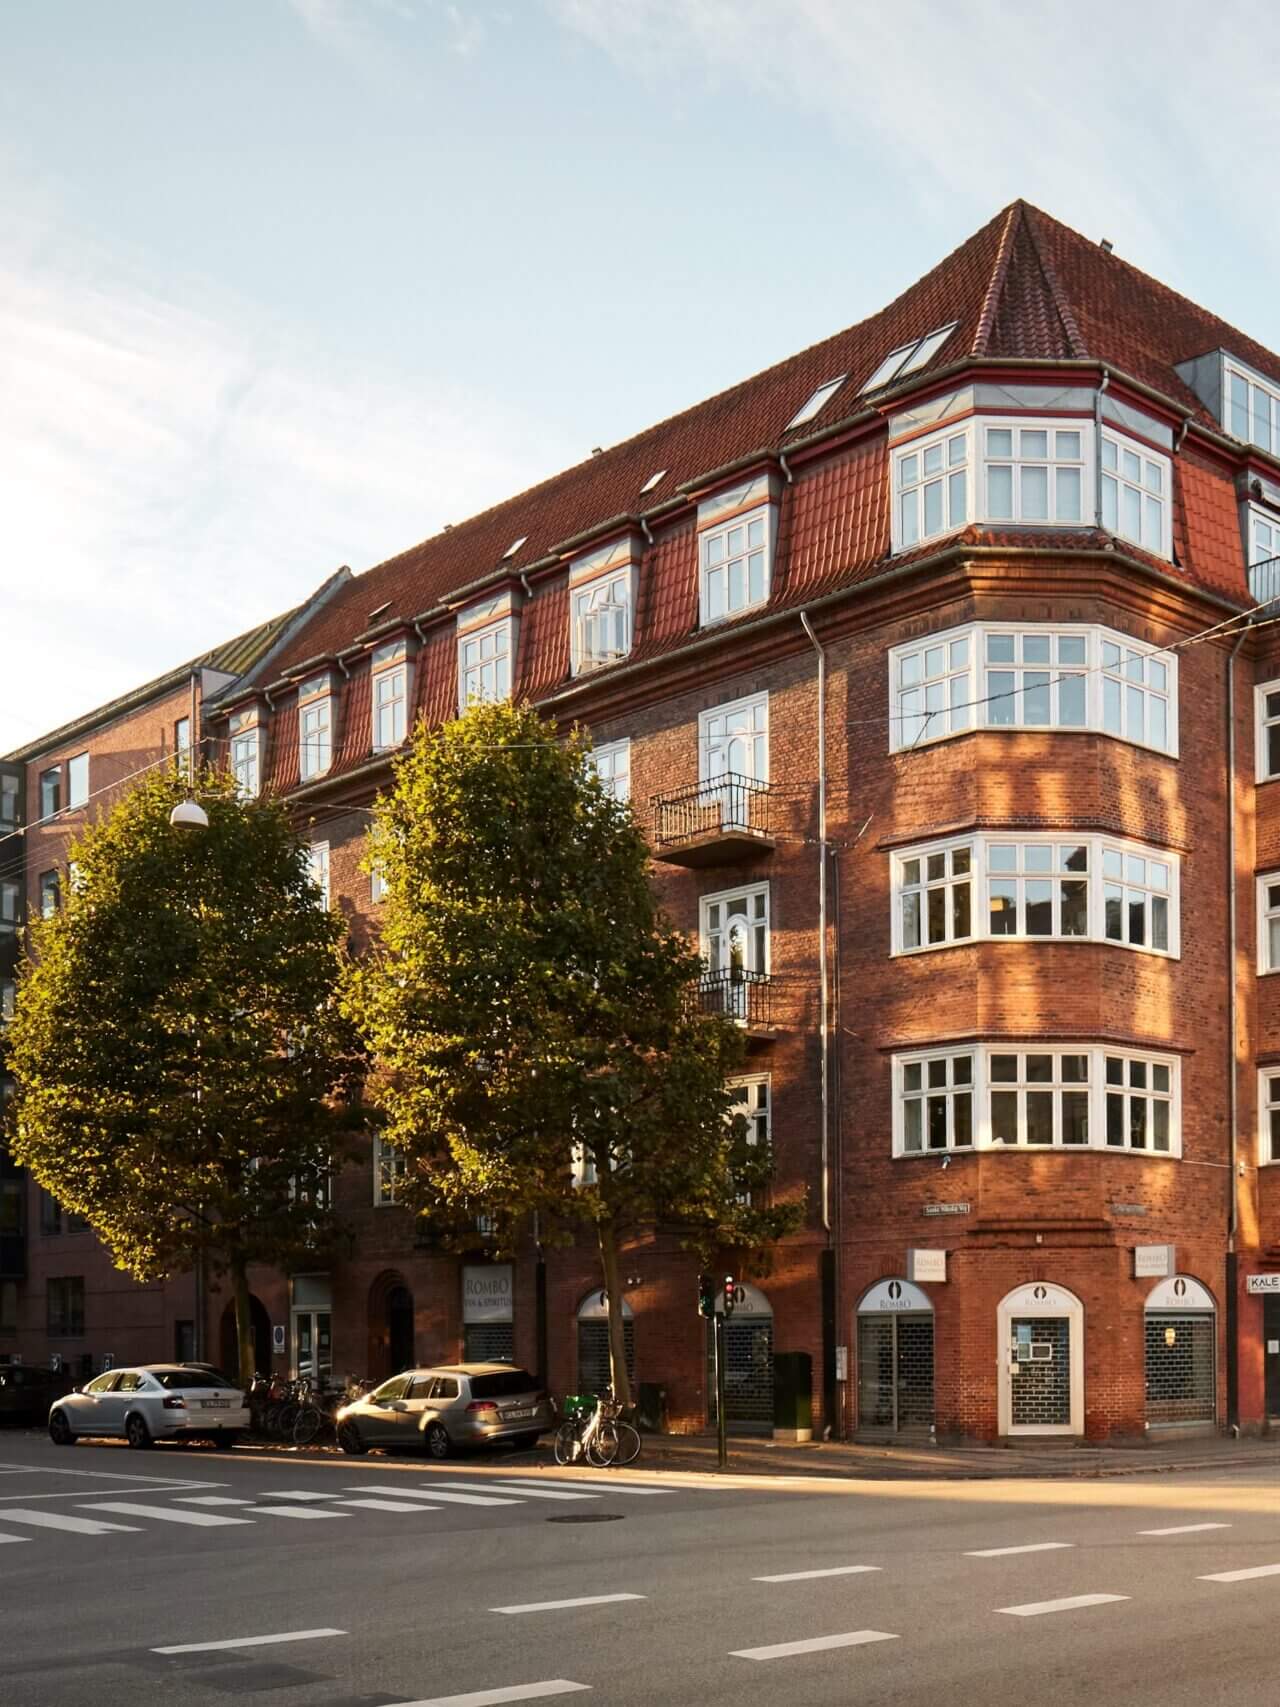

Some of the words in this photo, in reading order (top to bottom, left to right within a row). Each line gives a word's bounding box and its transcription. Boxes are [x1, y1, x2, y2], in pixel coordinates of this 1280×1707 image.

[1252, 1277, 1279, 1287] KALE
[466, 1279, 509, 1296] ROMBO
[880, 1299, 911, 1308] ROMBO
